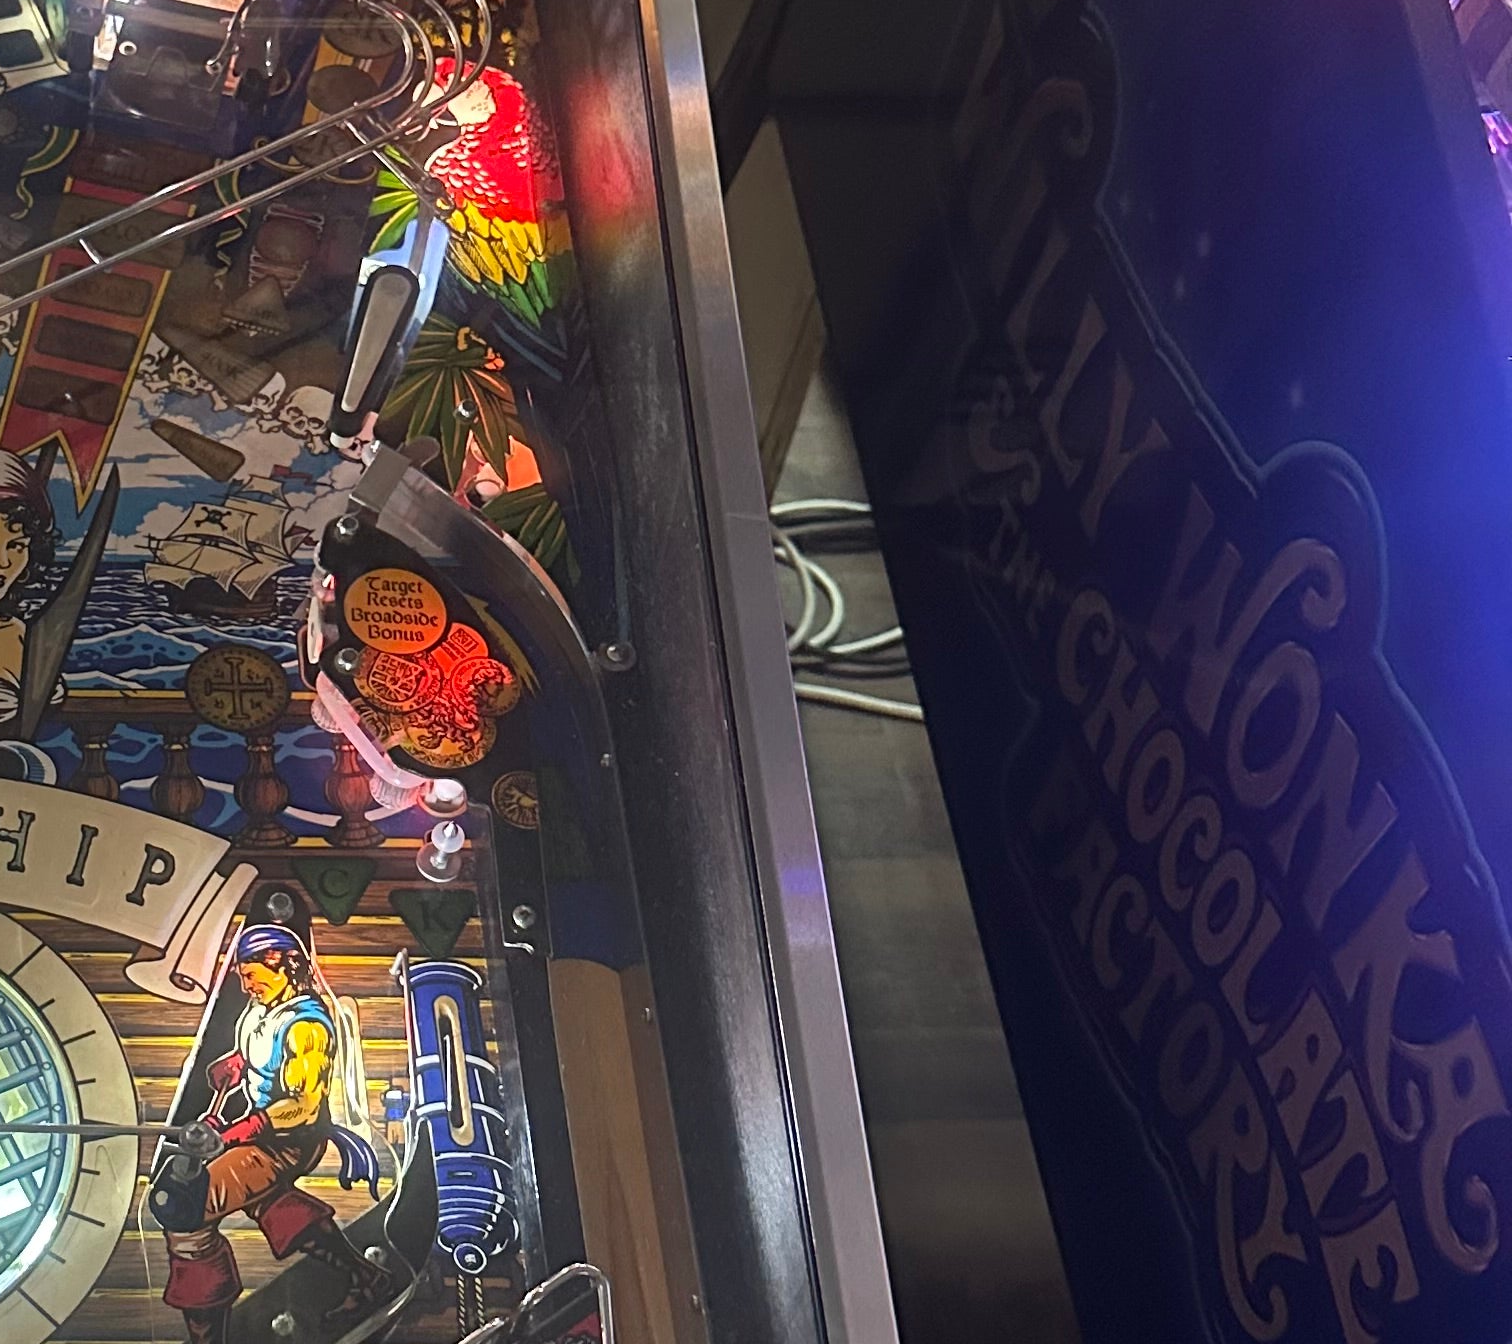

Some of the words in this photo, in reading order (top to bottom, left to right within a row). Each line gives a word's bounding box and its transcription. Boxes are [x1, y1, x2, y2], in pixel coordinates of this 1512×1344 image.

[365, 576, 423, 596] Target
[366, 591, 424, 609] Resets
[351, 607, 439, 627] Broadside
[368, 624, 425, 642] Bonus
[1149, 481, 1510, 1272] WONKA
[1028, 741, 1308, 1342] FACTORY
